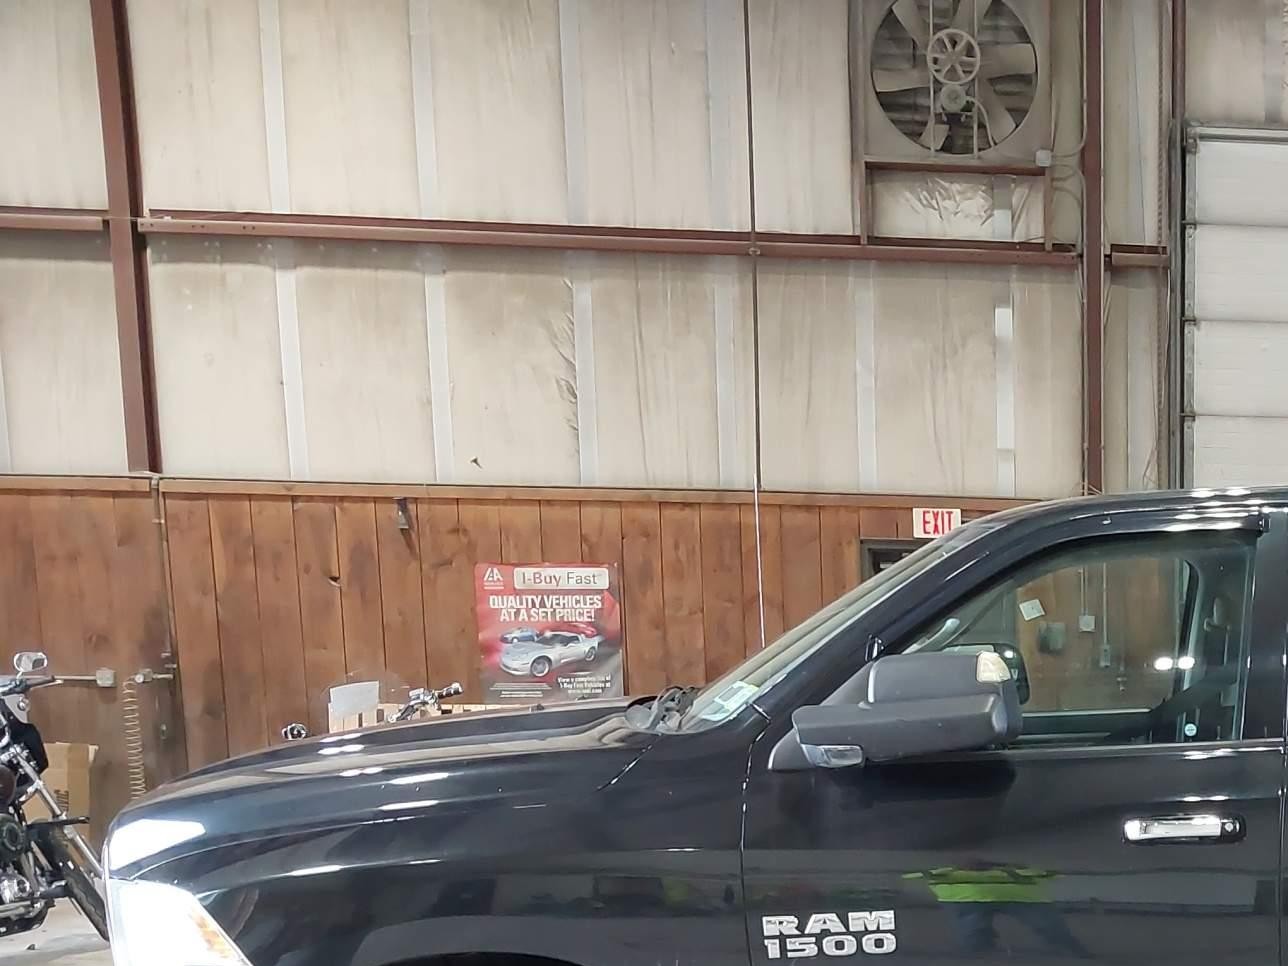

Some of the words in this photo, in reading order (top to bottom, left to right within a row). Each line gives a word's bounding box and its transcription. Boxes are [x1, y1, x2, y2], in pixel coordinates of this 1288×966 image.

[922, 510, 954, 535] EXIT
[522, 571, 562, 587] I-Buy
[566, 571, 598, 585] Fast
[489, 595, 541, 609] QUALITY
[543, 595, 602, 608] VEHICLES
[500, 609, 517, 622] AT
[518, 609, 529, 621] A
[530, 608, 554, 621] SET
[555, 608, 595, 622] PRICE!
[762, 910, 896, 936] RAM
[764, 932, 897, 959] 1500
